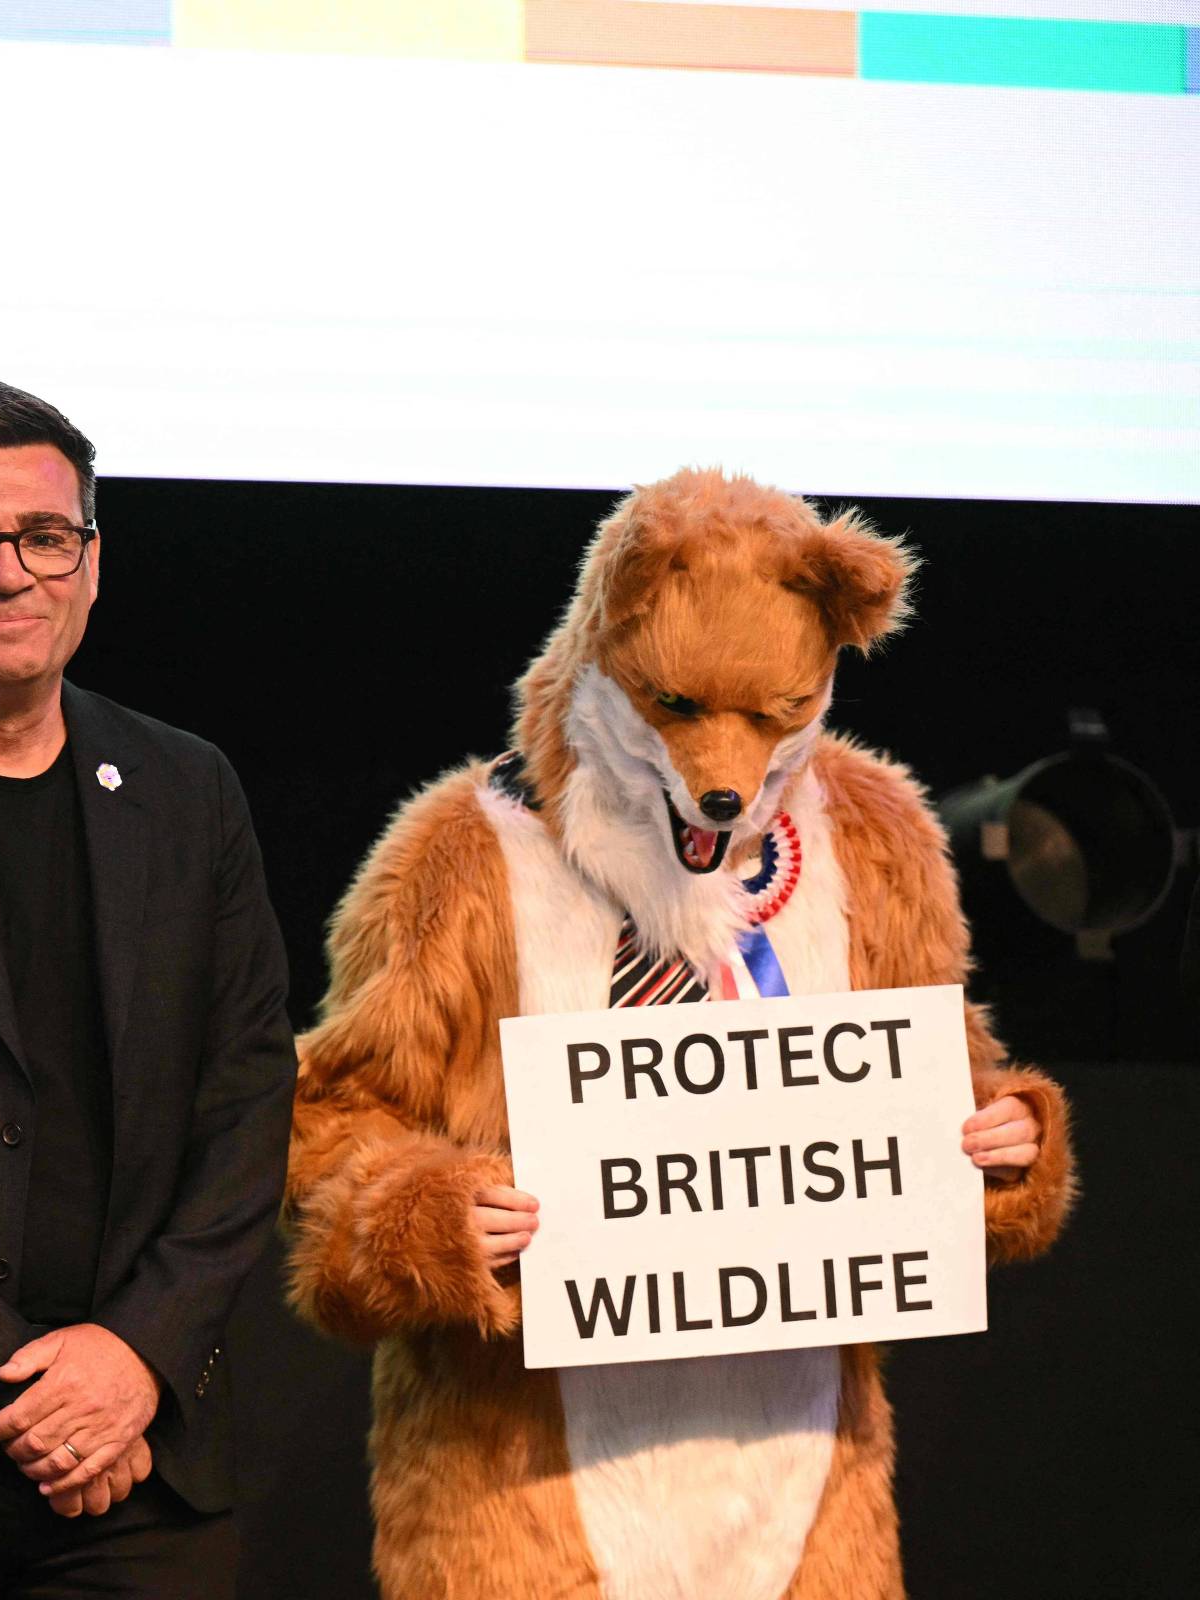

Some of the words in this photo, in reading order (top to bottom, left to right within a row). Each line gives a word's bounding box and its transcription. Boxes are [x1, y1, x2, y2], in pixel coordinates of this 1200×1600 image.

[566, 1018, 911, 1104] PROTECT
[600, 1136, 903, 1220] BRITISH
[564, 1250, 933, 1340] WILDLIFE
